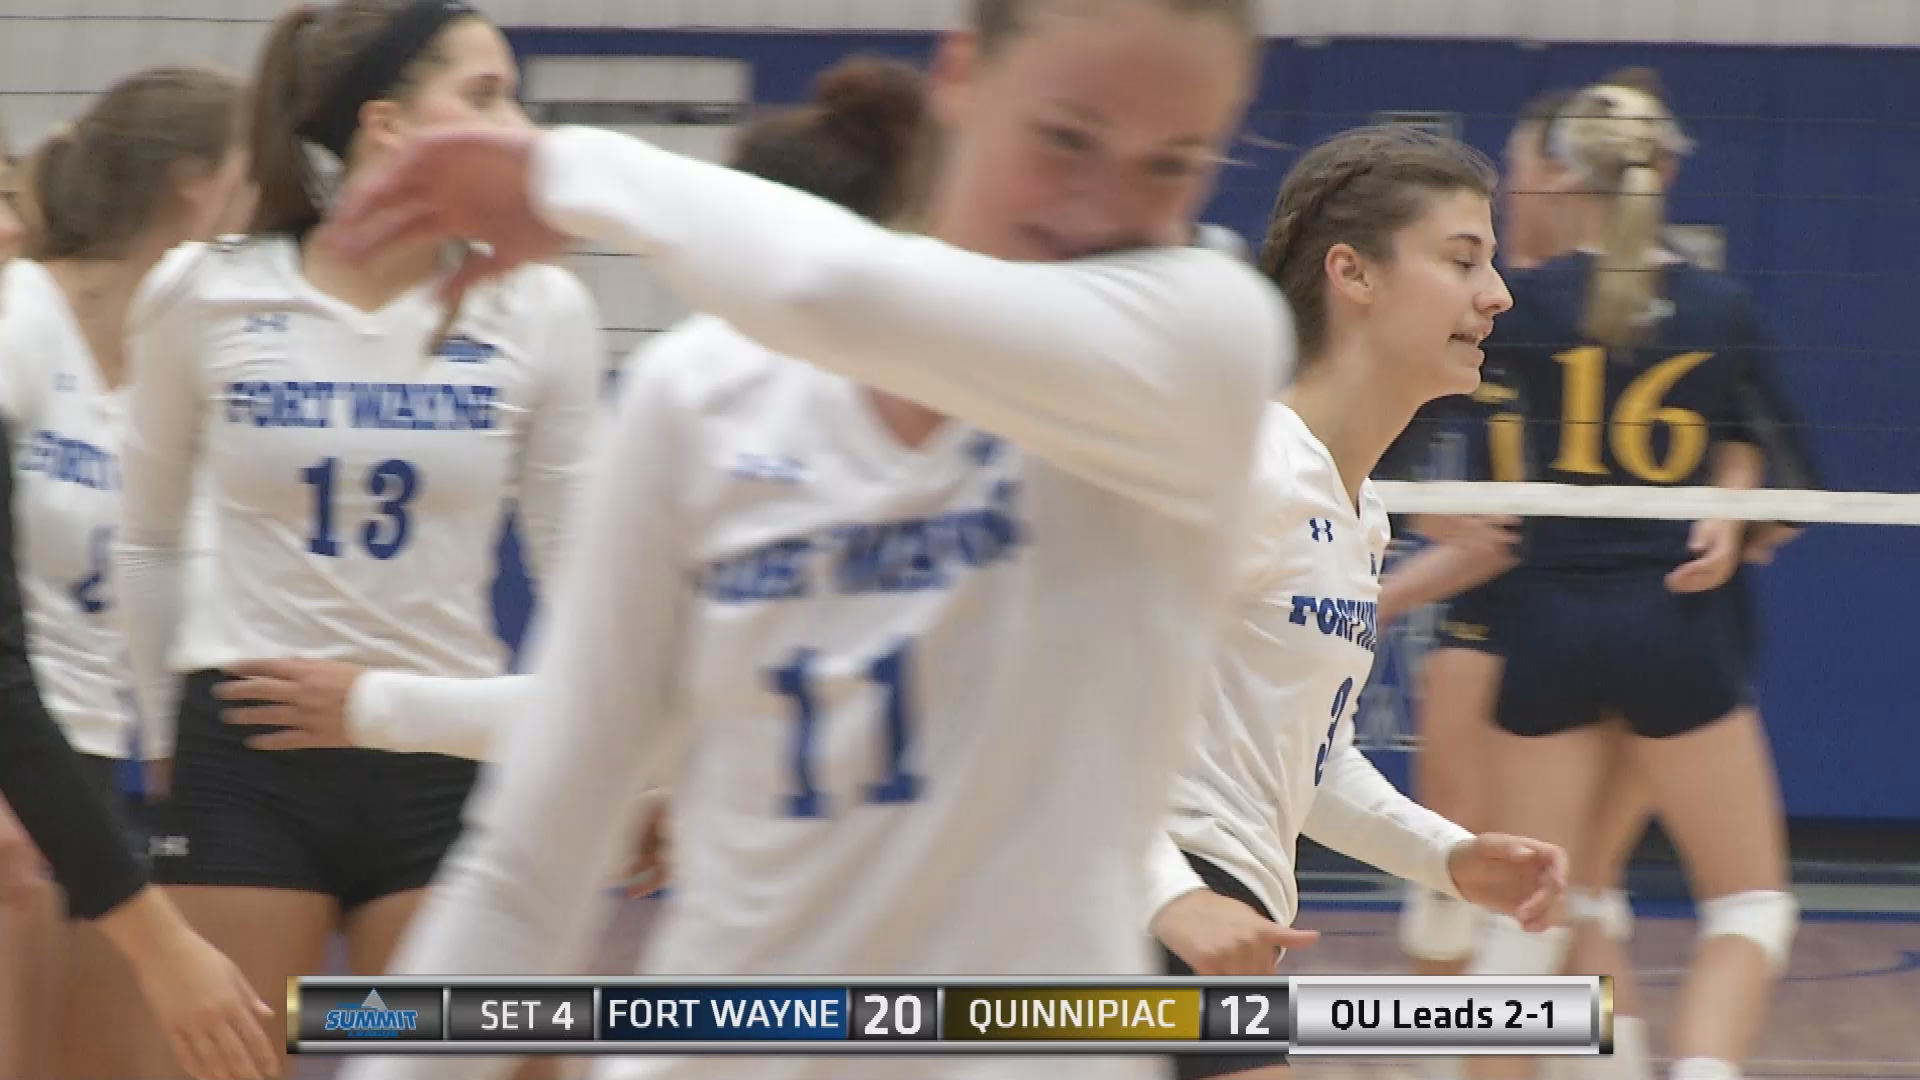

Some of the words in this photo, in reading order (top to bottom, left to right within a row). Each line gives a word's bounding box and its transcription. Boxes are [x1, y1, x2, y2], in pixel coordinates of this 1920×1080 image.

[1550, 344, 1715, 483] 16
[299, 456, 422, 561] 13
[763, 640, 923, 818] 11
